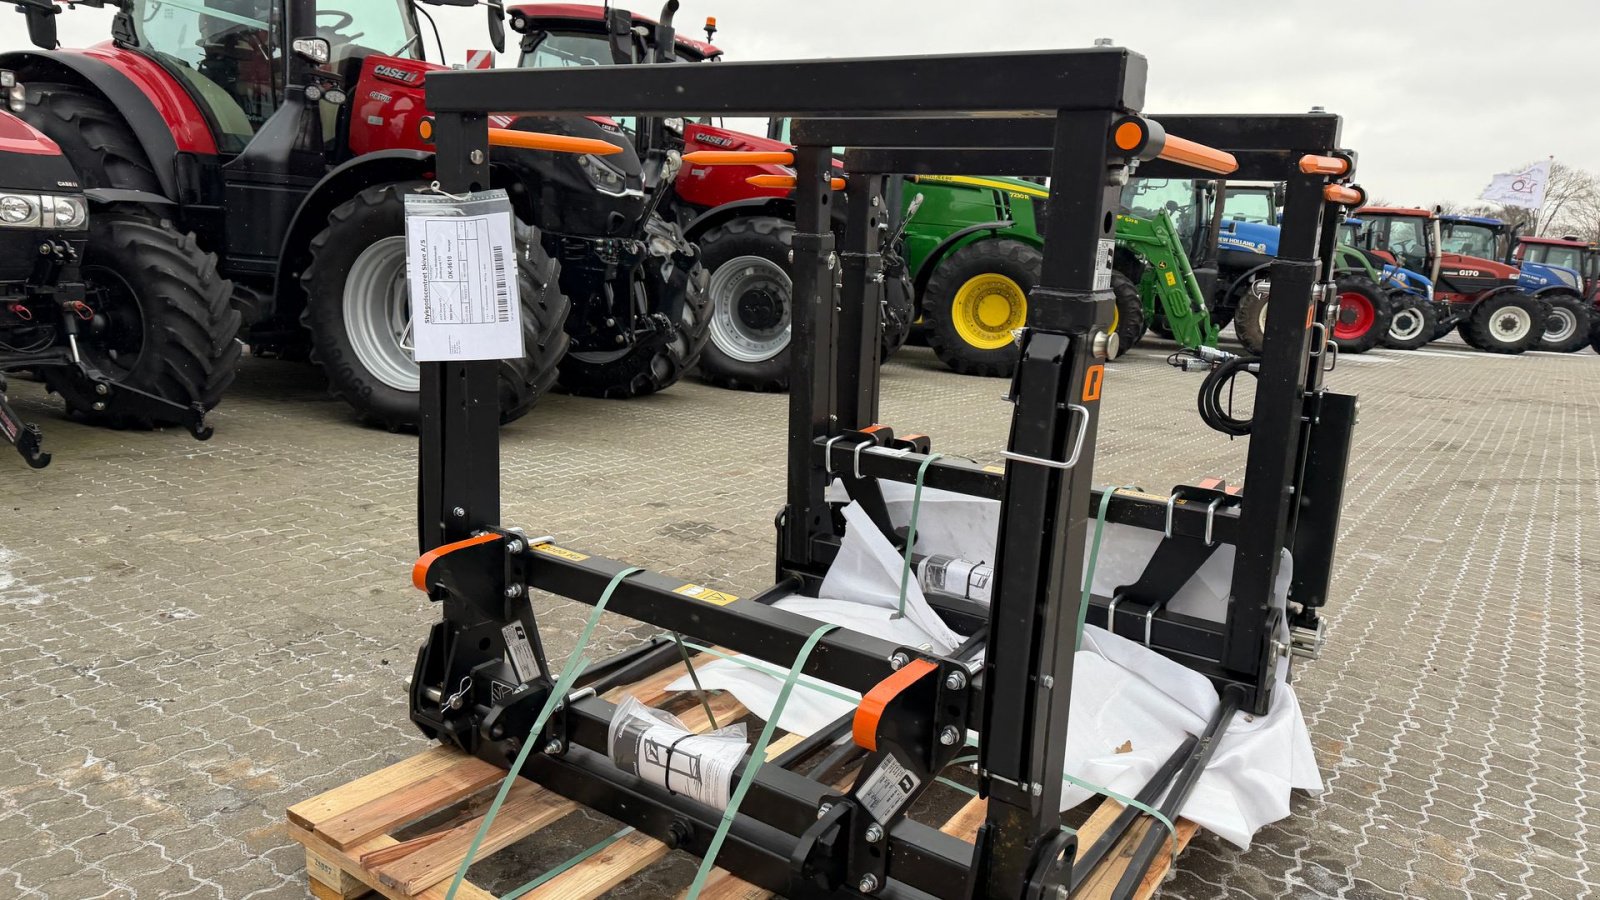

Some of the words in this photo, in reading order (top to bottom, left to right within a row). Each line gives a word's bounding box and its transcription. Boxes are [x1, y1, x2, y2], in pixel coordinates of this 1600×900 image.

[374, 64, 404, 79] CASE
[696, 132, 721, 144] CASE
[1229, 237, 1256, 248] HOLLAND
[1459, 269, 1480, 278] G170
